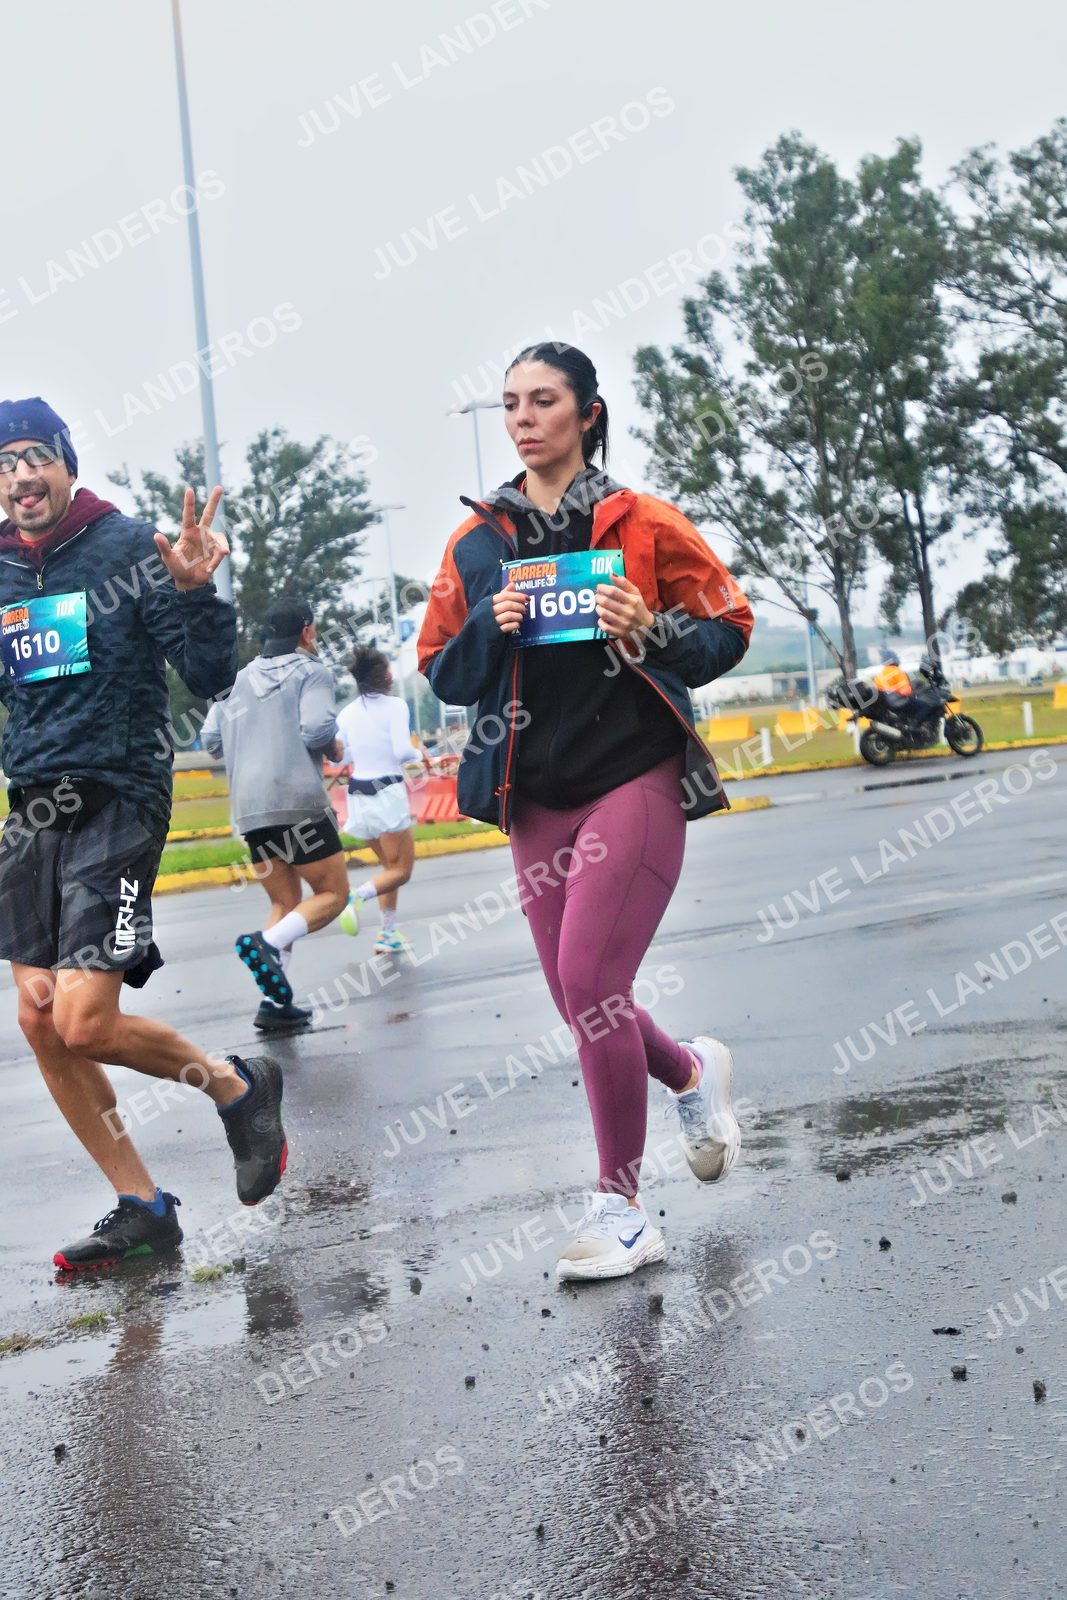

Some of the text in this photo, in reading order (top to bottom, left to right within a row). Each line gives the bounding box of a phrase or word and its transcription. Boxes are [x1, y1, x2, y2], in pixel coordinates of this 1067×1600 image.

[508, 562, 557, 582] CARRERA
[590, 557, 614, 575] 10K
[515, 579, 546, 591] MNILIFE
[56, 600, 75, 617] 10K
[525, 589, 596, 619] 1609
[2, 607, 29, 627] CARRERA
[11, 630, 60, 661] 1610
[115, 877, 139, 946] NIKE
